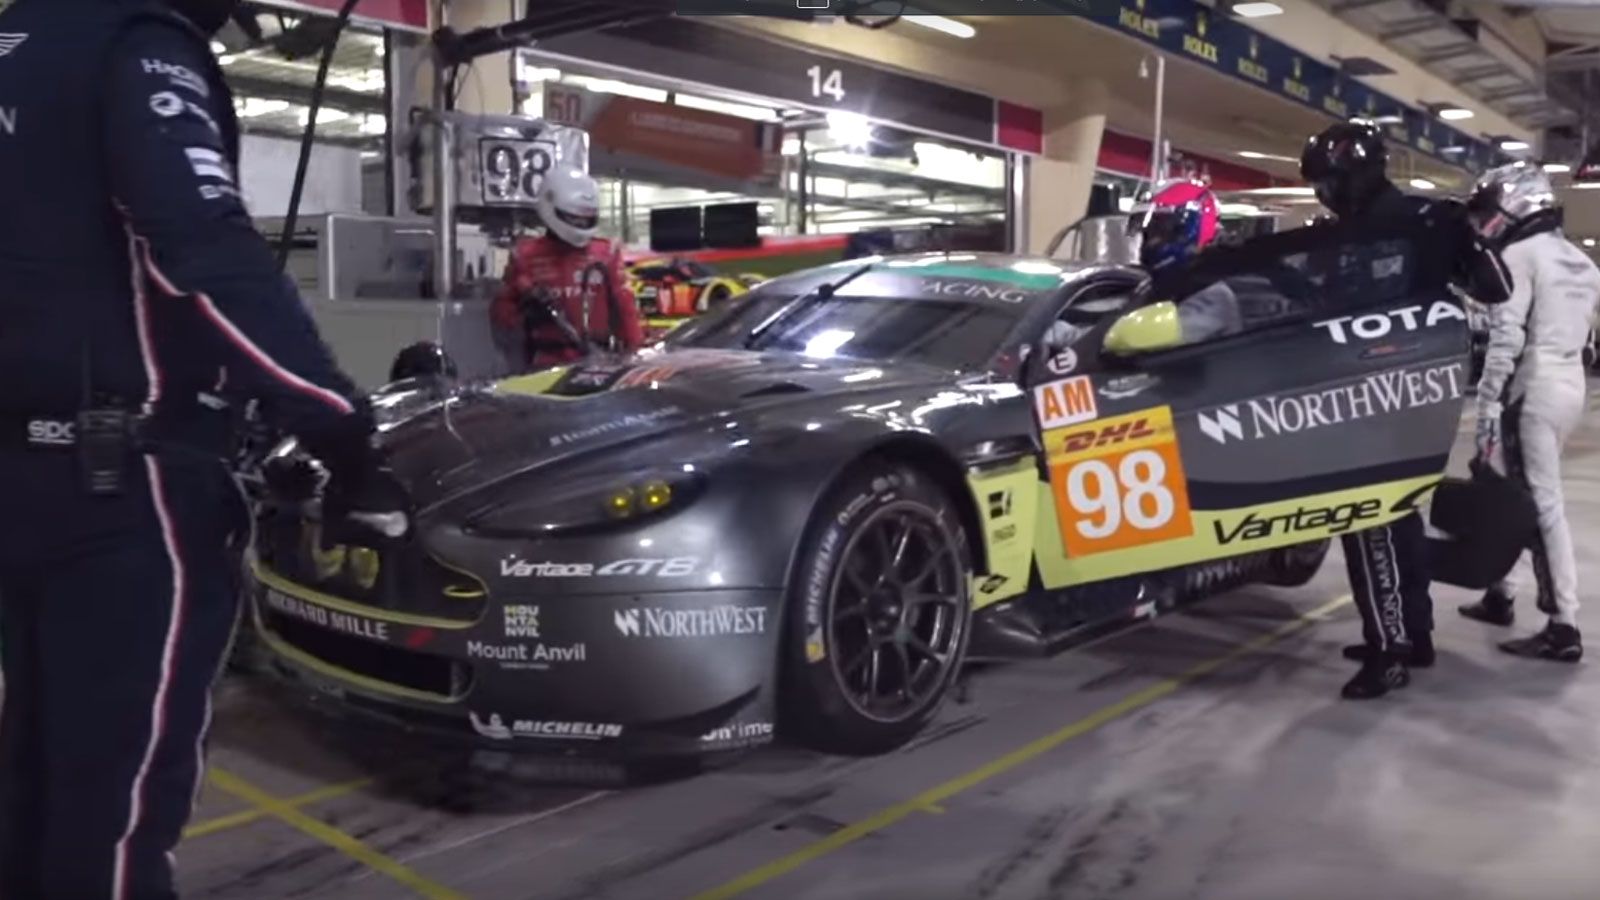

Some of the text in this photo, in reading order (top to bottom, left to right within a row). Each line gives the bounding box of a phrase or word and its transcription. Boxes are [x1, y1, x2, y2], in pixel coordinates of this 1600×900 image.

[1119, 6, 1160, 39] ROLEX
[1183, 34, 1218, 63] ROLEX
[806, 65, 846, 101] 14
[486, 145, 552, 199] 98
[921, 279, 1025, 303] ACING
[1313, 301, 1466, 345] TOTA
[1042, 377, 1093, 422] AM
[1248, 362, 1463, 440] NORTHWEST
[1063, 417, 1157, 454] DHL
[1066, 449, 1176, 540] 98
[1212, 499, 1382, 546] Vantage
[500, 559, 595, 578] Vantage
[330, 611, 391, 642] MILLE
[644, 605, 768, 637] NORTHWEST
[466, 640, 587, 662] Mount Anvil
[512, 719, 623, 738] MICHELIN
